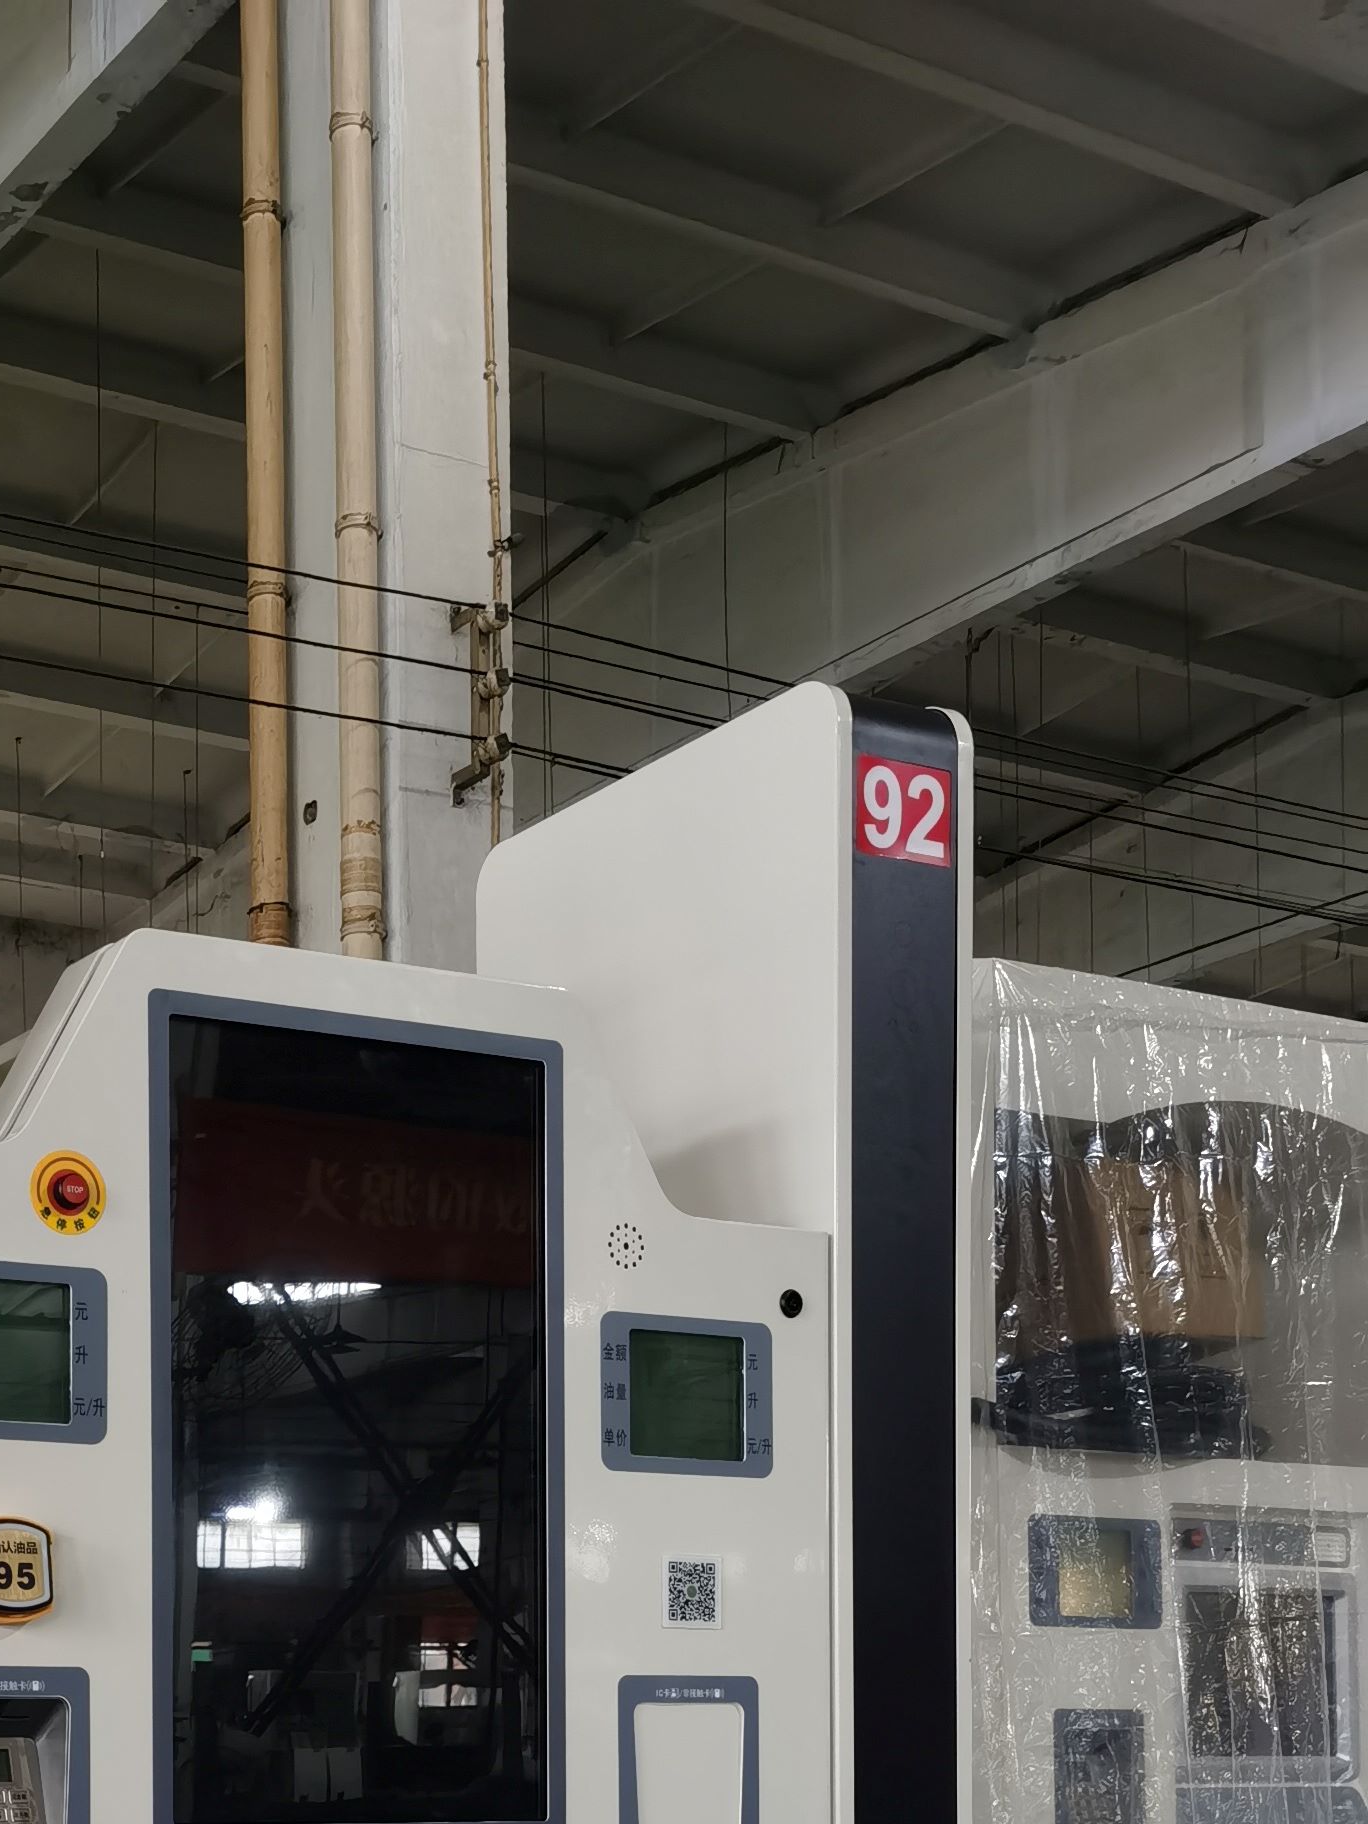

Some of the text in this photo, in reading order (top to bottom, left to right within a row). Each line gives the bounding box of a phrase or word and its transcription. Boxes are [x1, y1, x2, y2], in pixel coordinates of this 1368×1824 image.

[863, 765, 945, 859] 92
[66, 1185, 84, 1194] STOP
[74, 1301, 89, 1321] 元
[74, 1345, 89, 1365] 升
[602, 1342, 627, 1362] 金额
[746, 1353, 759, 1371] 元
[603, 1382, 627, 1401] 油量
[746, 1391, 759, 1410] 升
[73, 1396, 106, 1418] 元/升
[603, 1428, 628, 1448] 单价
[746, 1437, 773, 1456] 元/升
